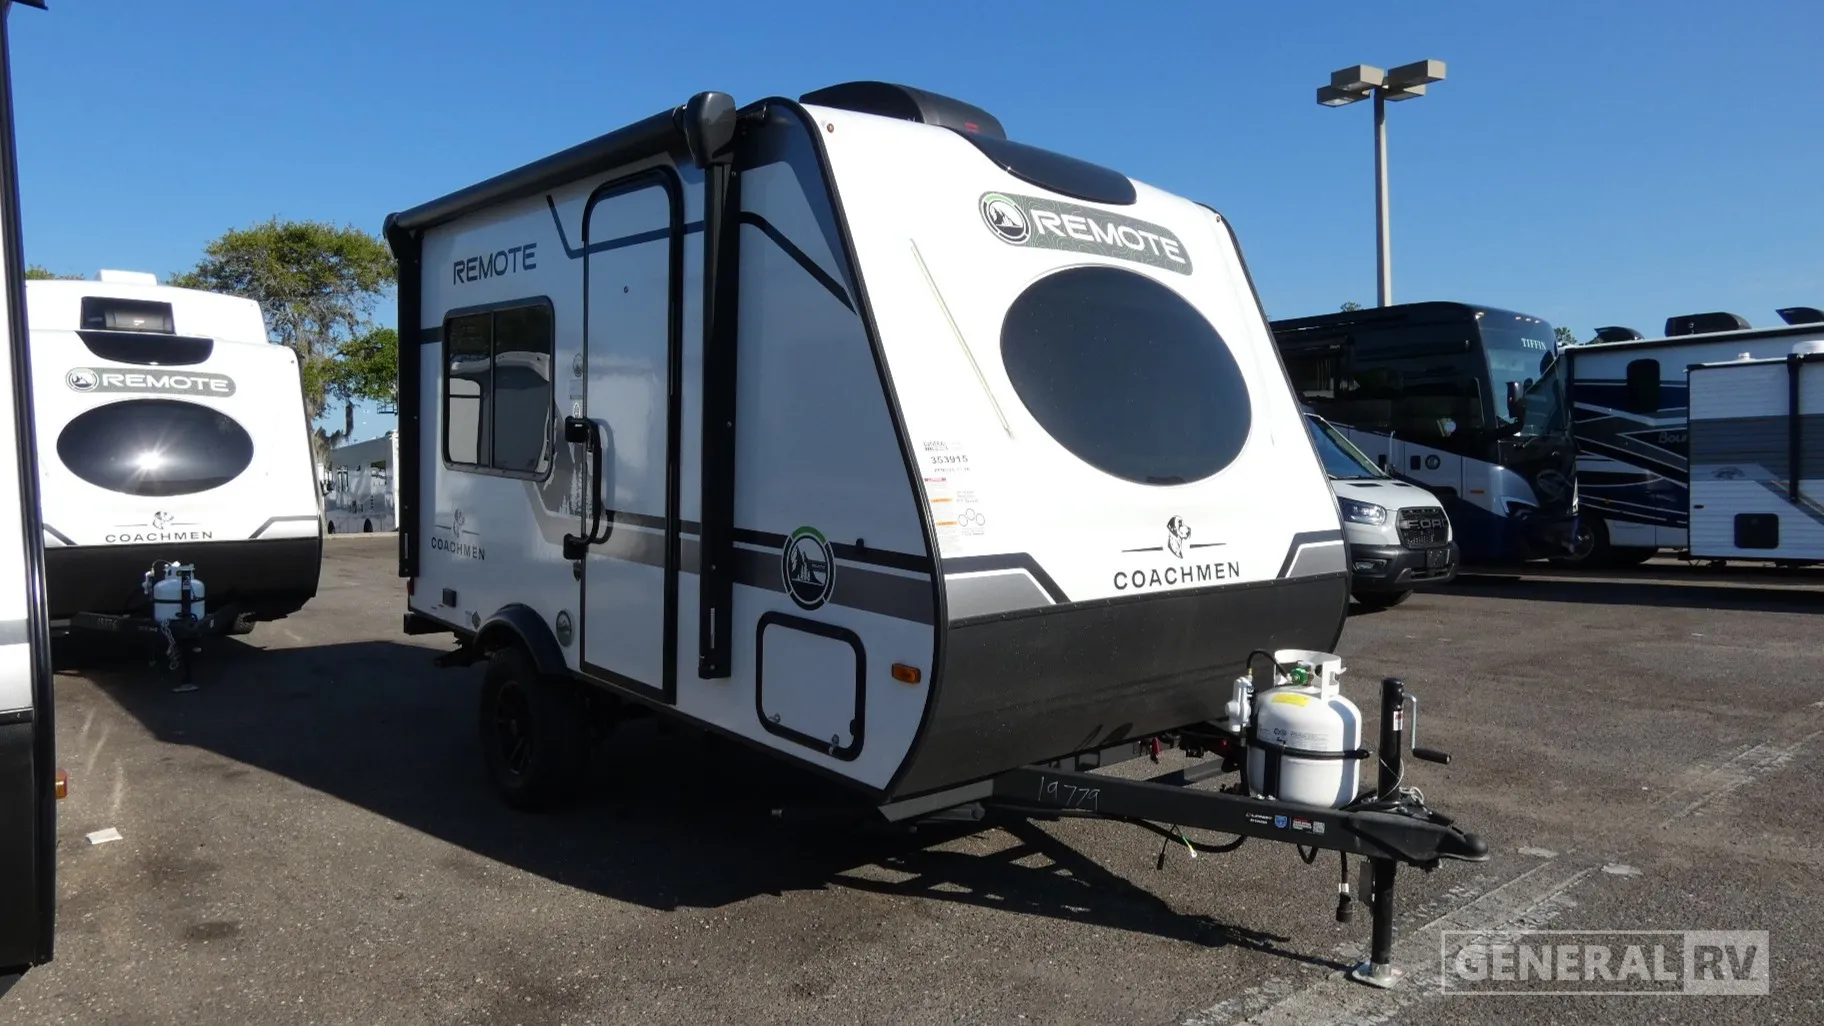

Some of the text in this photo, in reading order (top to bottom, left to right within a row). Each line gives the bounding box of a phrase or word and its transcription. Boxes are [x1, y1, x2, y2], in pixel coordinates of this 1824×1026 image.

[1030, 209, 1187, 264] REMOTE
[453, 242, 537, 285] REMOTE
[101, 373, 230, 392] REMOTE
[105, 530, 213, 543] COACHMEN
[431, 536, 485, 561] COACHMEN
[1113, 561, 1240, 590] COACHMEN
